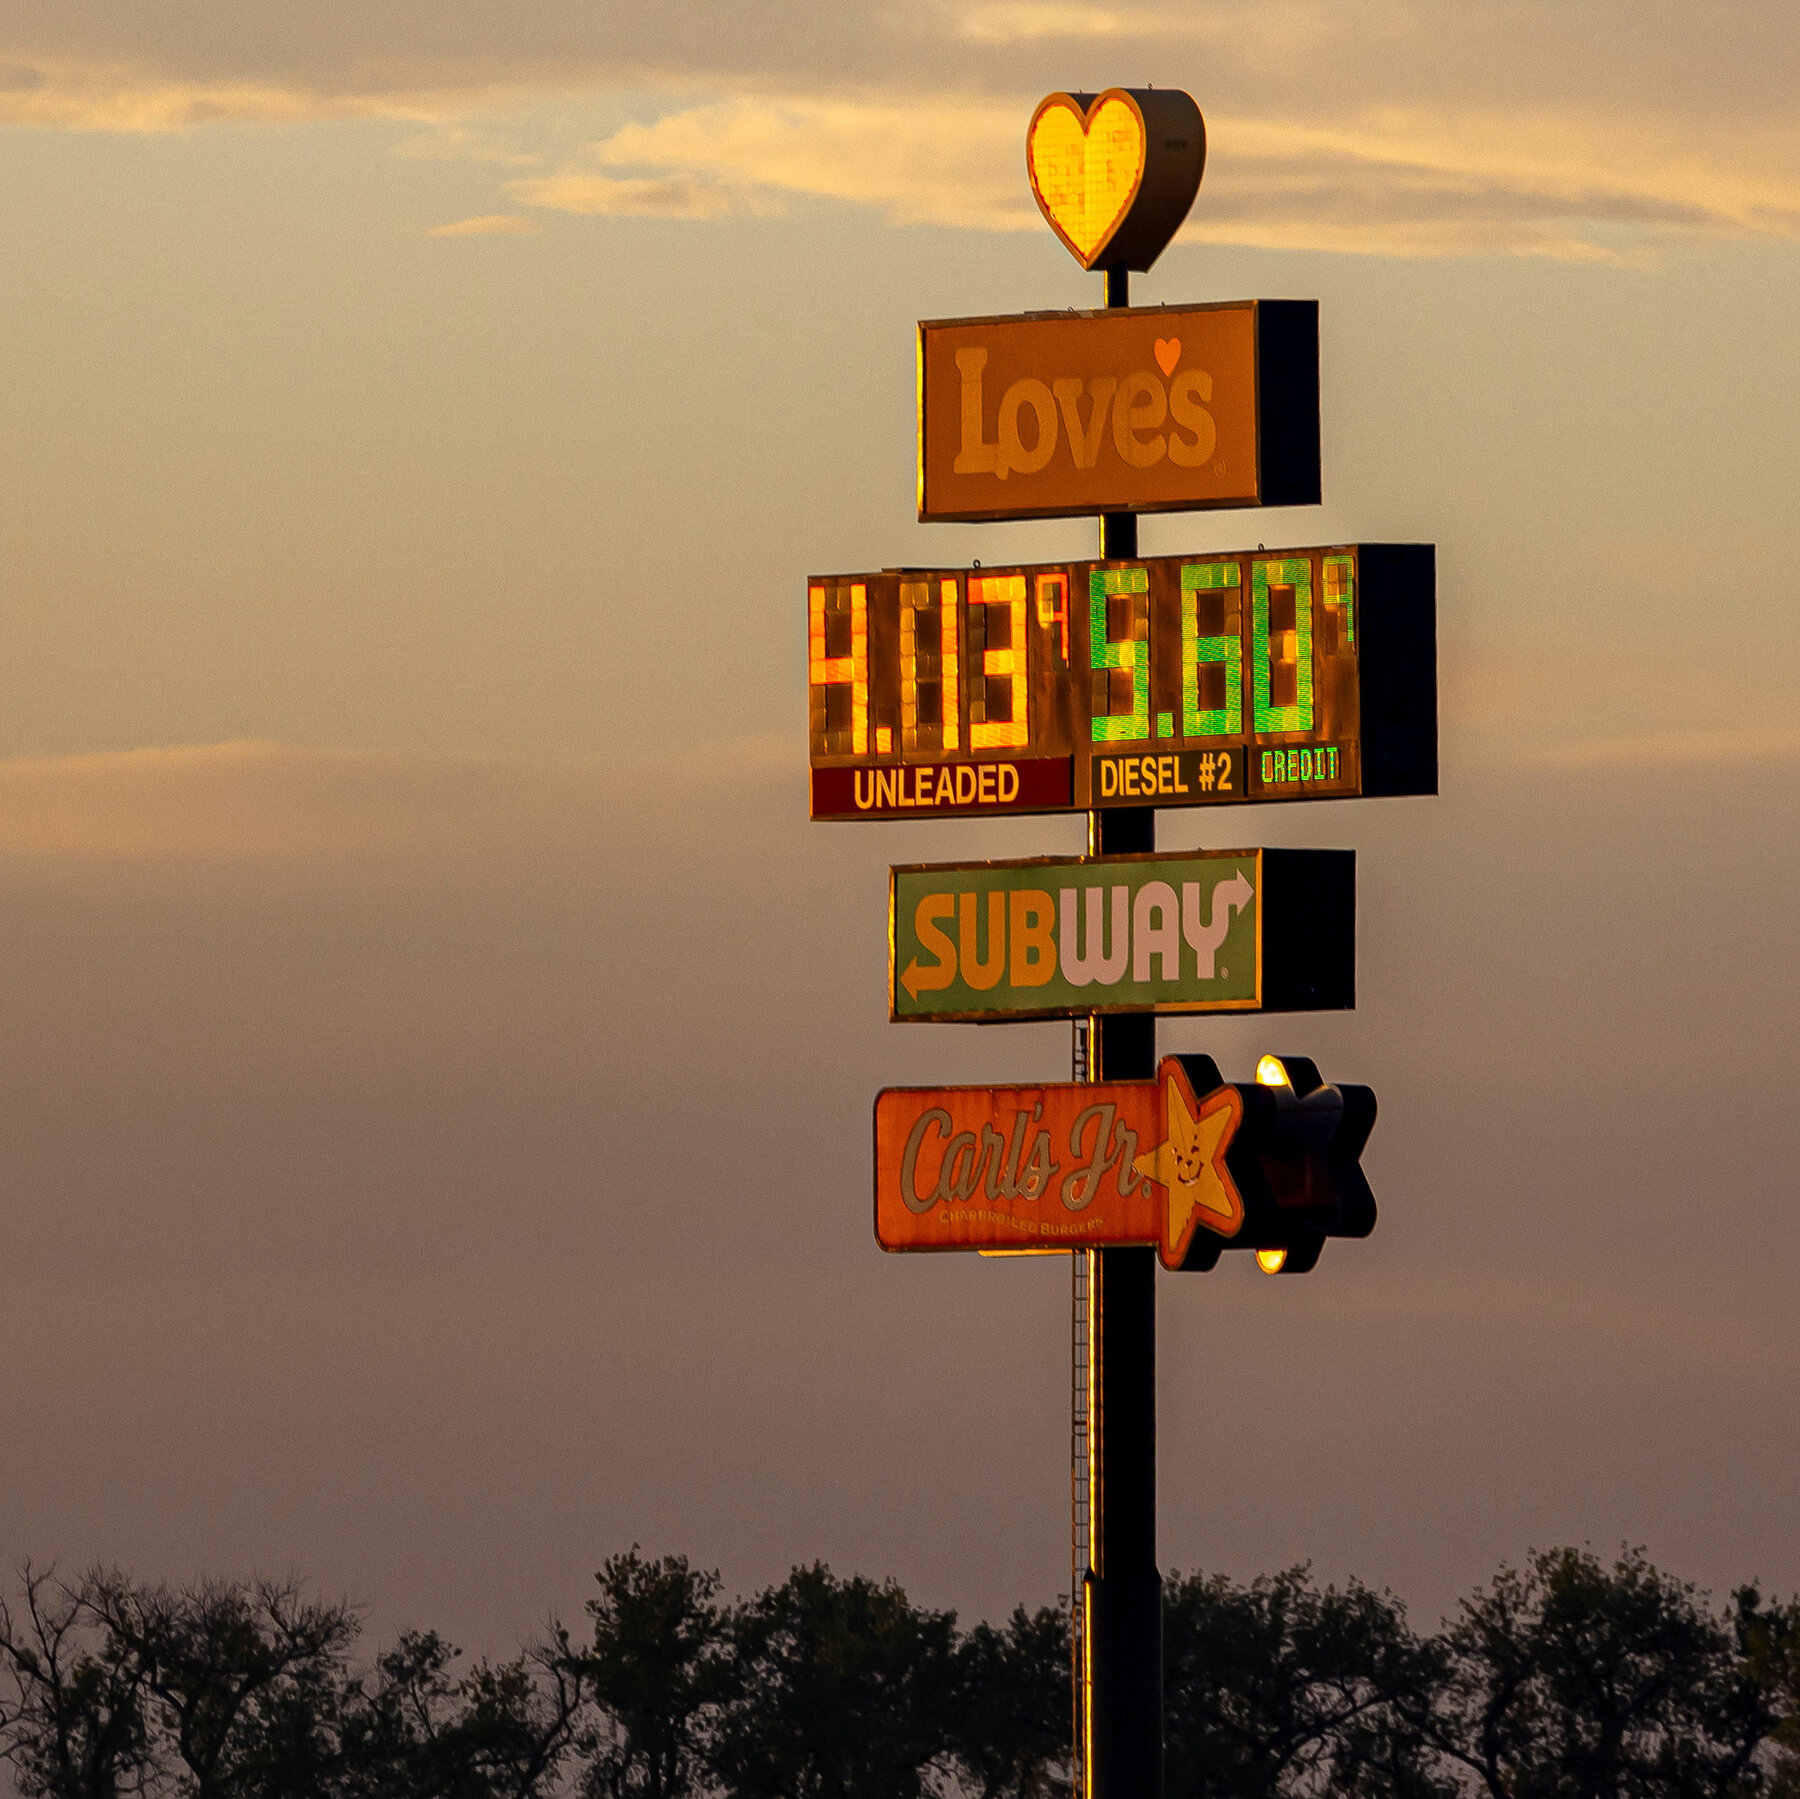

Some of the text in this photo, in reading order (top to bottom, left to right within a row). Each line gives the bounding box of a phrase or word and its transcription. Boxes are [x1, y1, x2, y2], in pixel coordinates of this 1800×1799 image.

[953, 337, 1217, 480] Love's
[854, 763, 1020, 810] UNLEADED
[1101, 752, 1233, 797] DIESEL #2
[1261, 747, 1338, 783] CREDIT
[900, 868, 1255, 1001] SUBWAY
[901, 1101, 1152, 1215] Carl's Jr.
